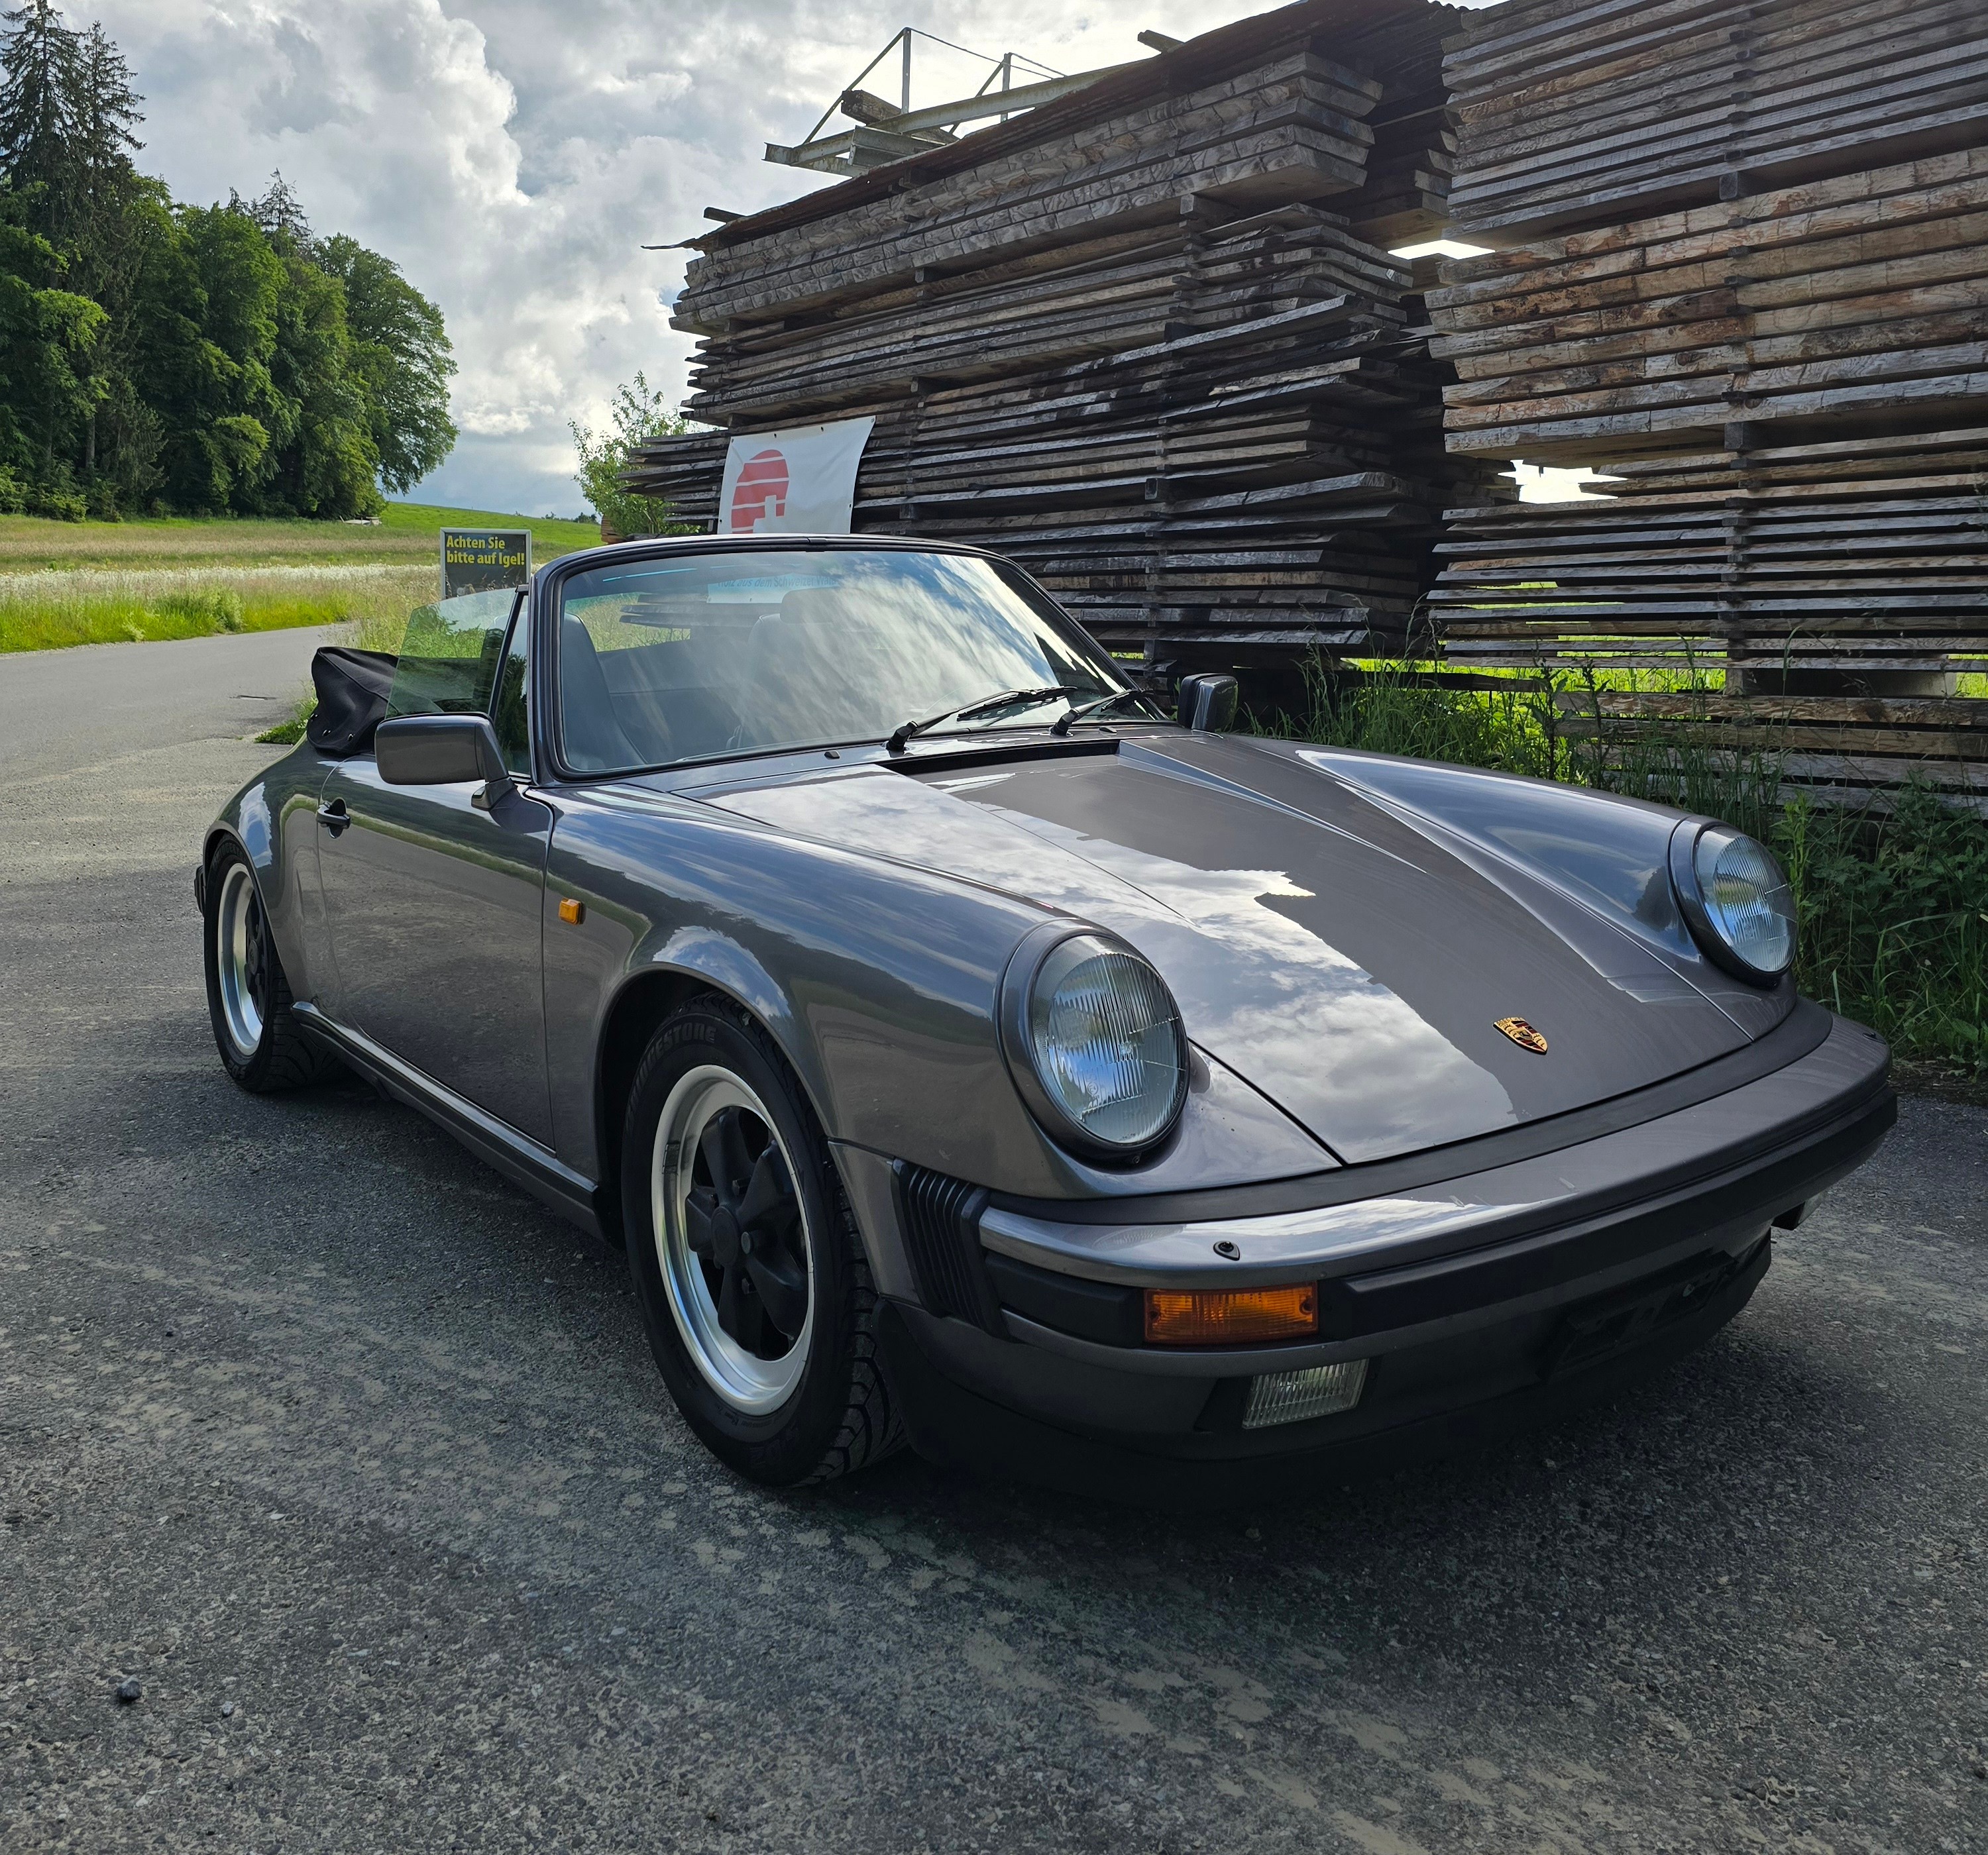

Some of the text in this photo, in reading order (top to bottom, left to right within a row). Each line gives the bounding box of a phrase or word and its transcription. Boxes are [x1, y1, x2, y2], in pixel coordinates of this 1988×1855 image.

[447, 535, 505, 549] Achten Sie
[447, 551, 525, 568] bitte auf Igel!
[737, 578, 753, 587] aus
[754, 578, 772, 588] dem
[773, 575, 814, 588] Schweizer
